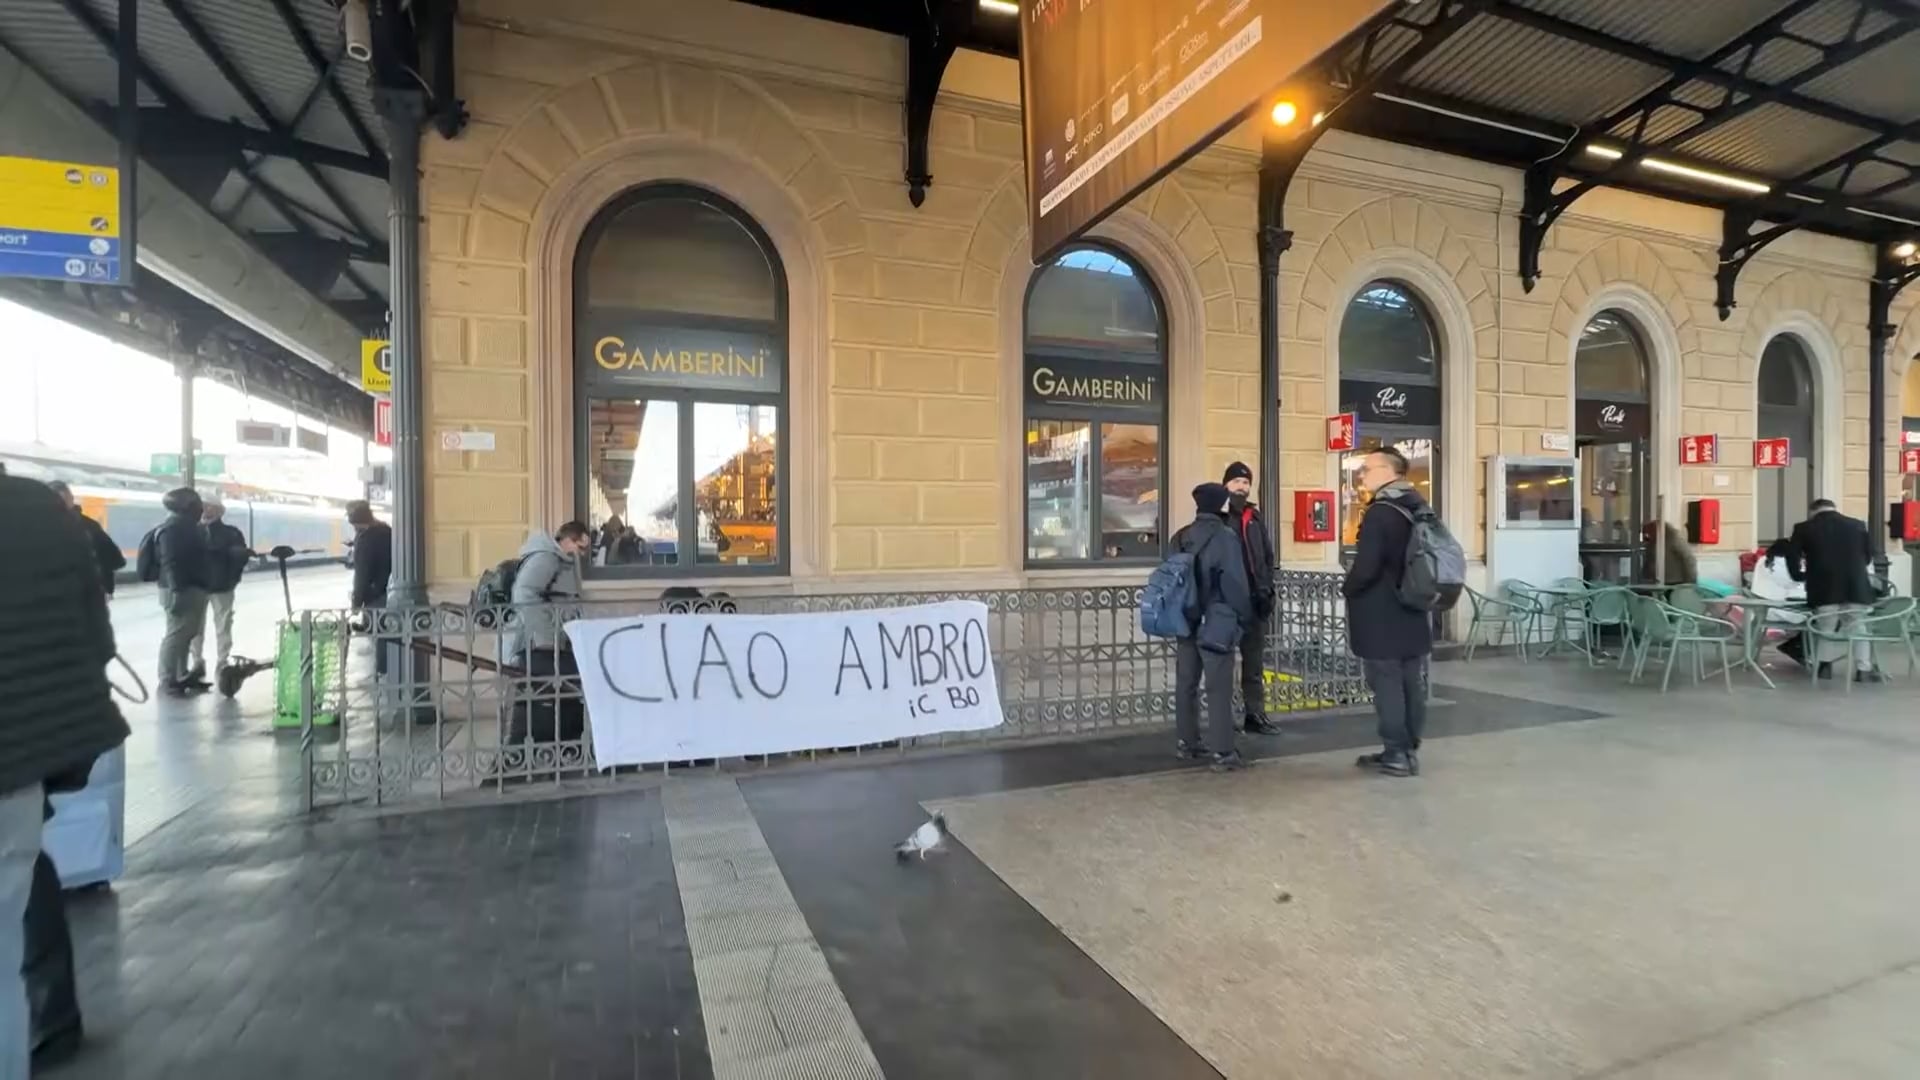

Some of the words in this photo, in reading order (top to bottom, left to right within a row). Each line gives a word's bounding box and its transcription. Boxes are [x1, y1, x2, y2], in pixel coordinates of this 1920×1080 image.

[598, 622, 788, 703] CIAO
[833, 617, 987, 696] AMBRO
[946, 685, 981, 710] BO
